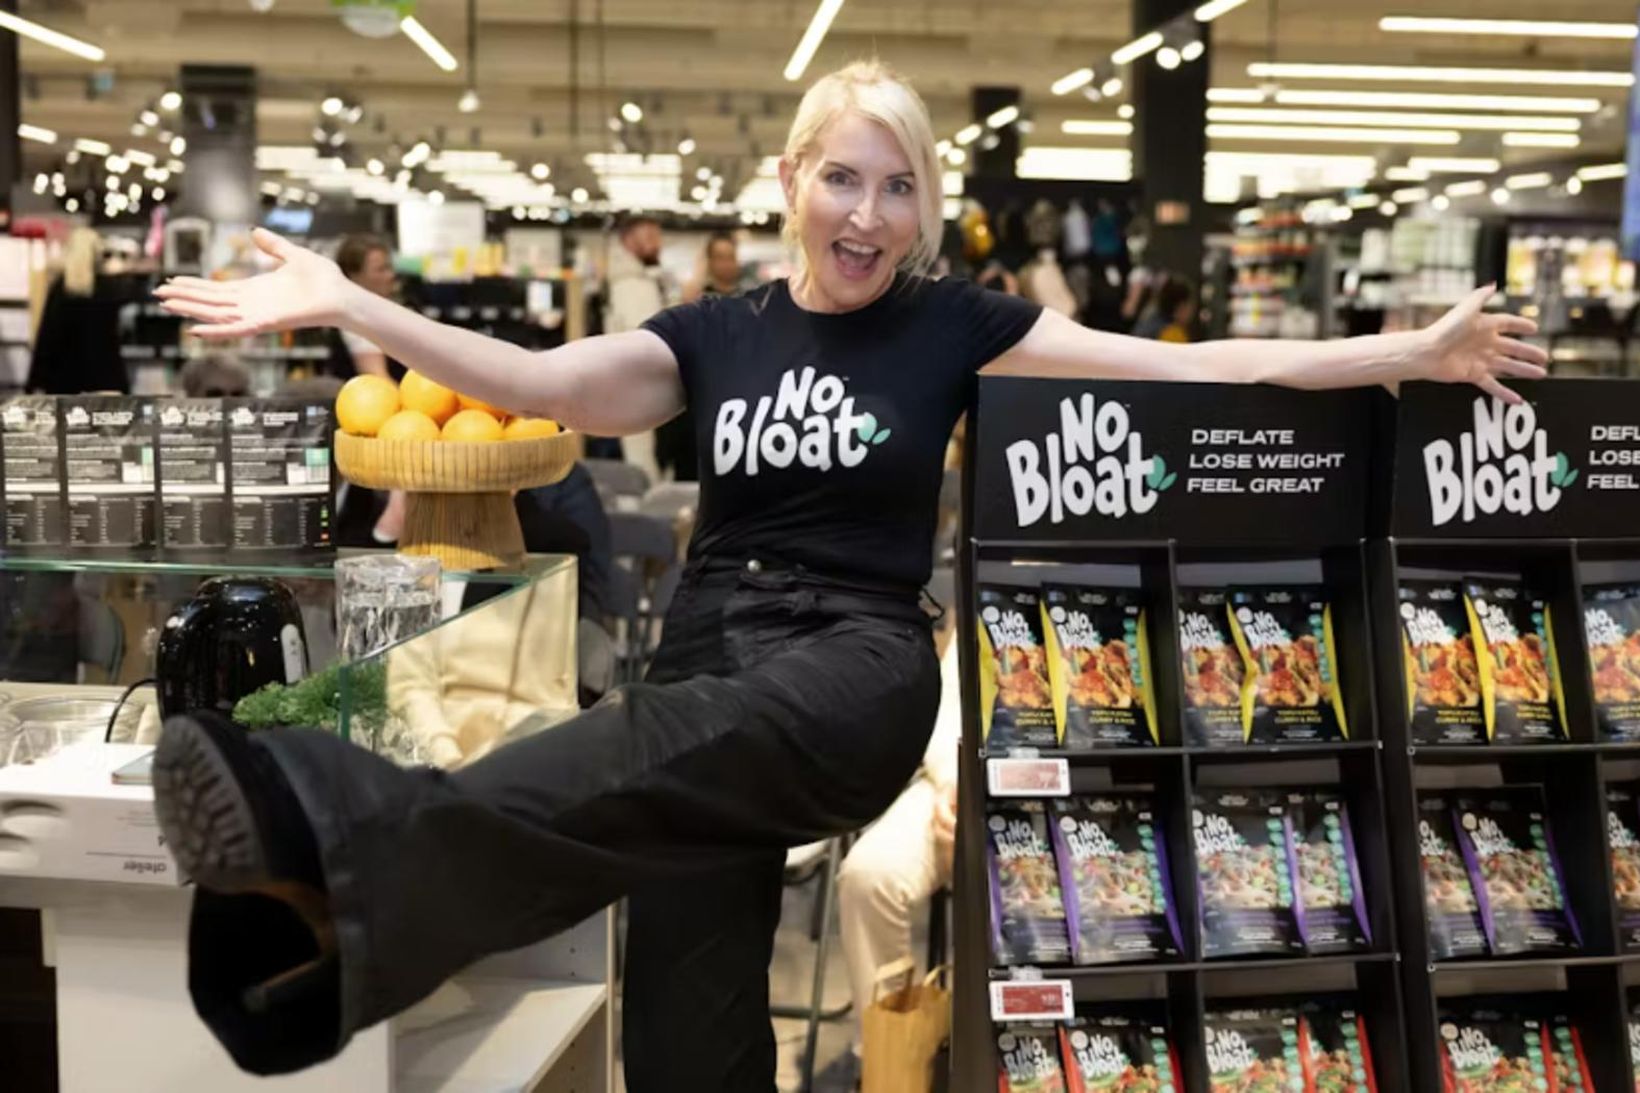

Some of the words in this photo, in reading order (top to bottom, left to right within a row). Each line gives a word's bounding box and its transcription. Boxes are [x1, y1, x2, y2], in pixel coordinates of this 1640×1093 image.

[714, 396, 869, 476] Bloat
[1191, 429, 1295, 445] DEFLATE
[1189, 453, 1253, 469] LOSE
[1256, 453, 1345, 469] WEIGHT
[1005, 431, 1158, 528] Bloat
[1187, 478, 1246, 493] FEEL
[1249, 478, 1325, 493] GREAT
[1423, 428, 1562, 527] Bloat
[1587, 474, 1640, 489] FEEL
[993, 831, 1045, 860] Bloat
[1067, 831, 1116, 862] Bloat
[1192, 825, 1243, 856] Bloat
[123, 861, 167, 874] atelier
[1003, 1047, 1055, 1081] Bloat
[1077, 1046, 1127, 1080] Bloat
